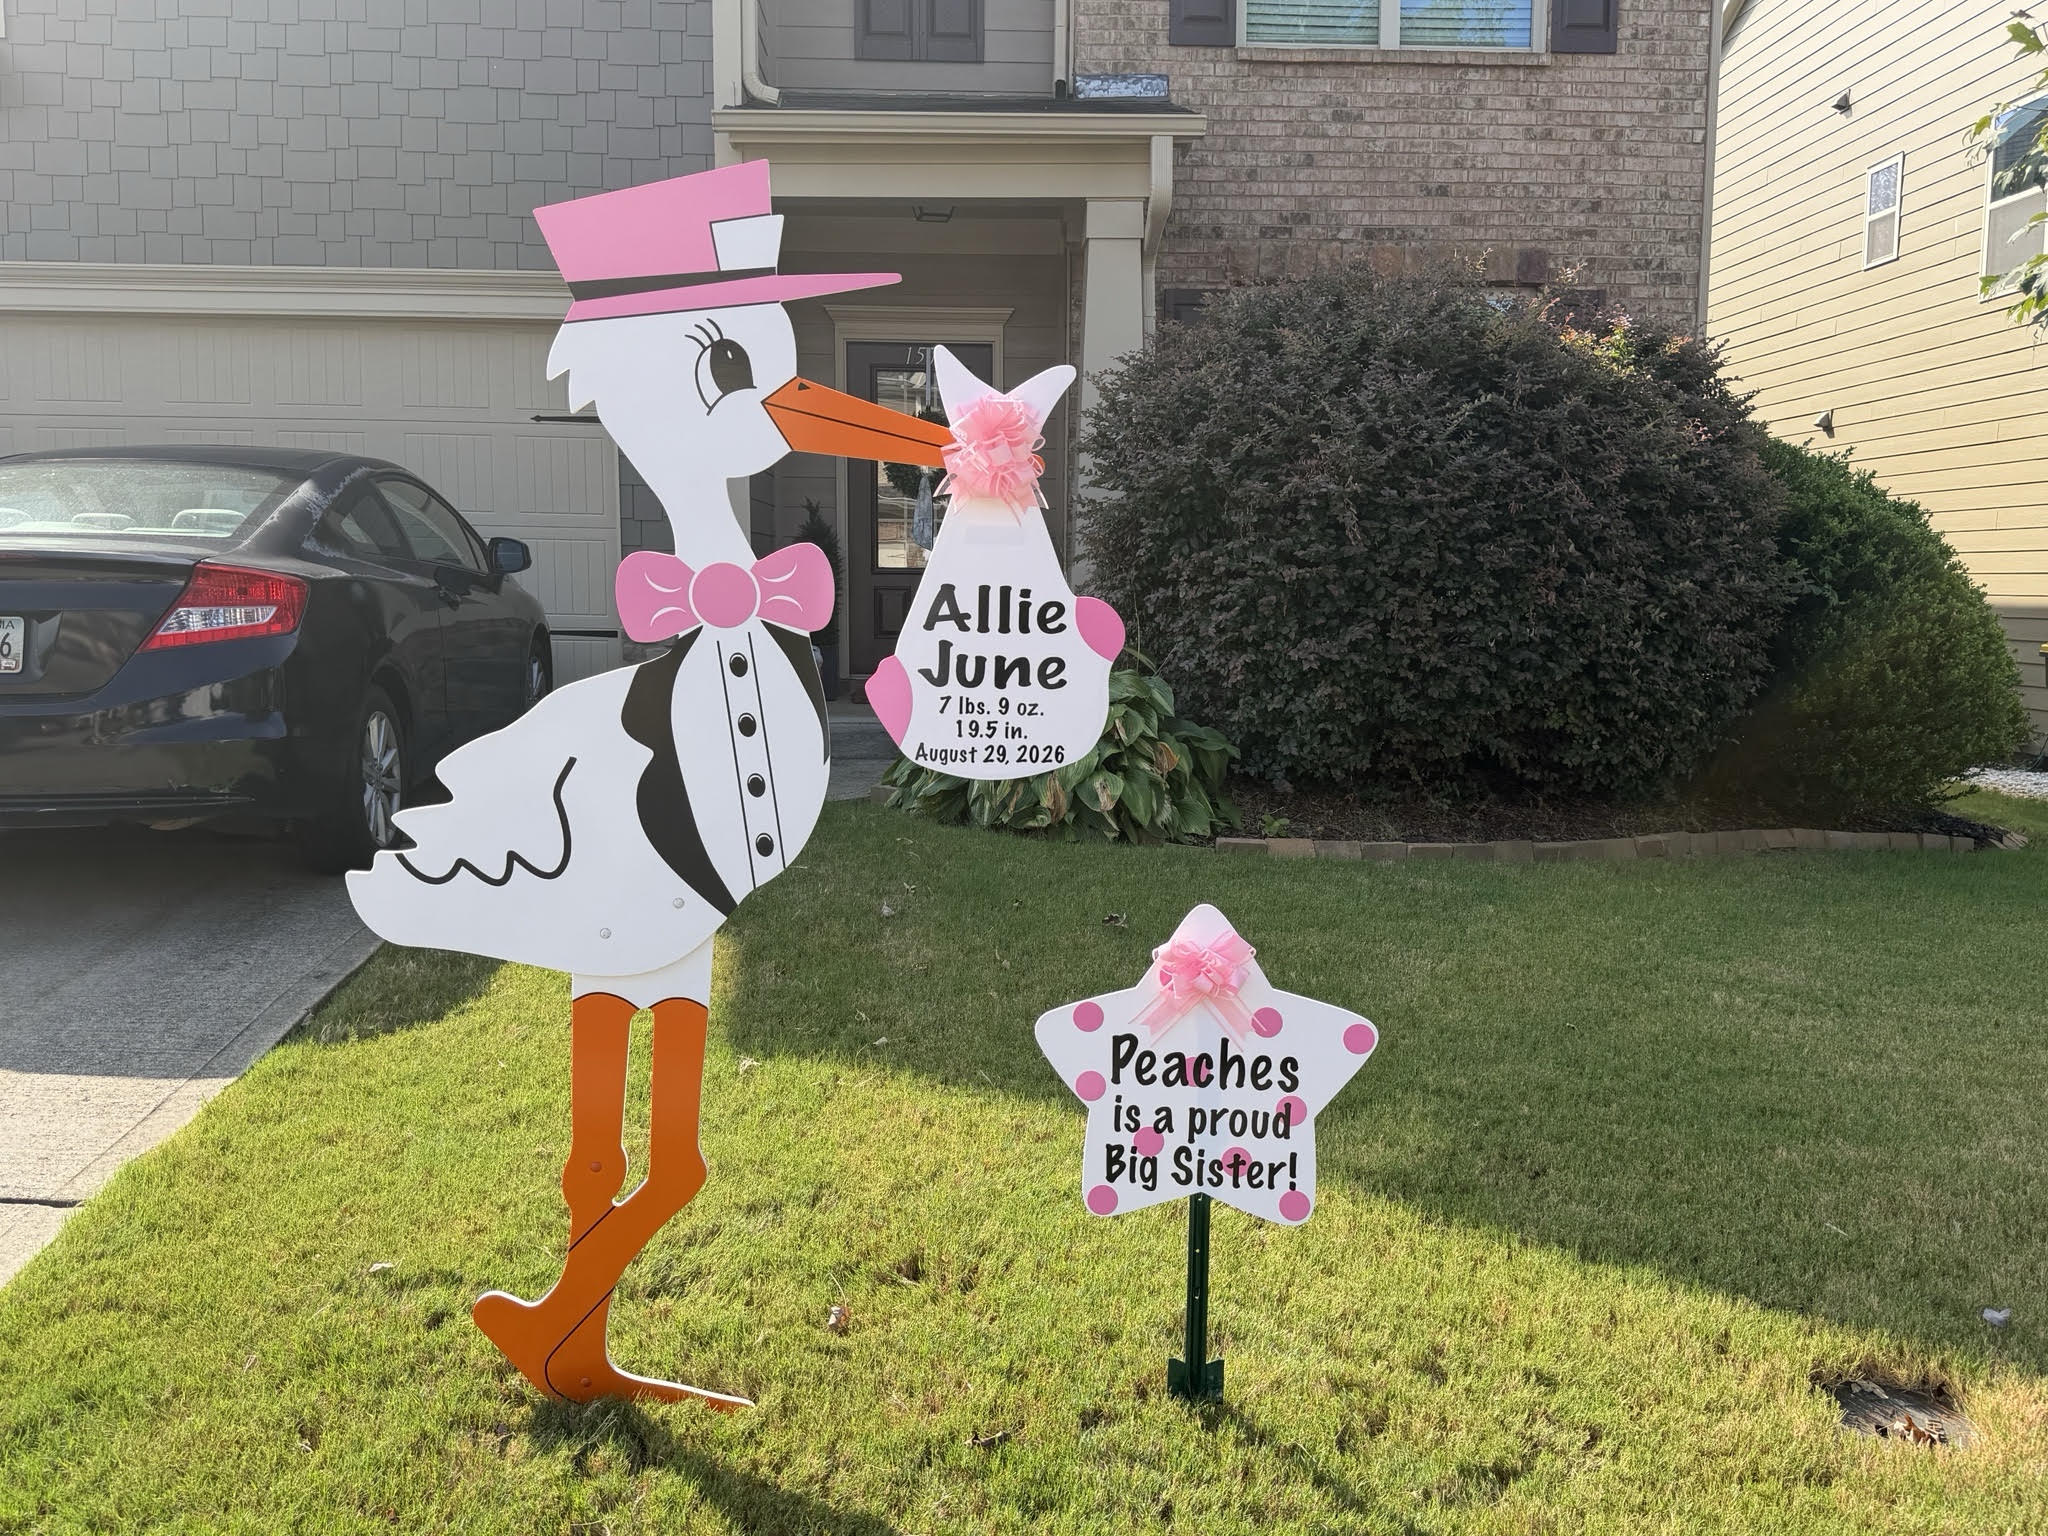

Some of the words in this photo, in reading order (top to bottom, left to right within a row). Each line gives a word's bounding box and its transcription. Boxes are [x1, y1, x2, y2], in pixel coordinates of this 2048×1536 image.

[923, 583, 1067, 634] Allie
[918, 640, 1067, 689] June
[939, 695, 952, 714] 7
[959, 695, 990, 715] lbs.
[998, 696, 1010, 716] 9
[1017, 702, 1044, 717] oz.
[957, 720, 998, 738] 19.5
[1004, 721, 1028, 740] in.
[915, 742, 978, 766] August
[982, 744, 1010, 765] 29,
[1015, 744, 1065, 764] 2026
[1111, 1033, 1299, 1093] Peaches
[1114, 1095, 1140, 1133] is
[1153, 1107, 1174, 1134] a
[1188, 1103, 1291, 1144] proud
[1106, 1144, 1157, 1191] Big
[1170, 1145, 1298, 1192] Sister!
